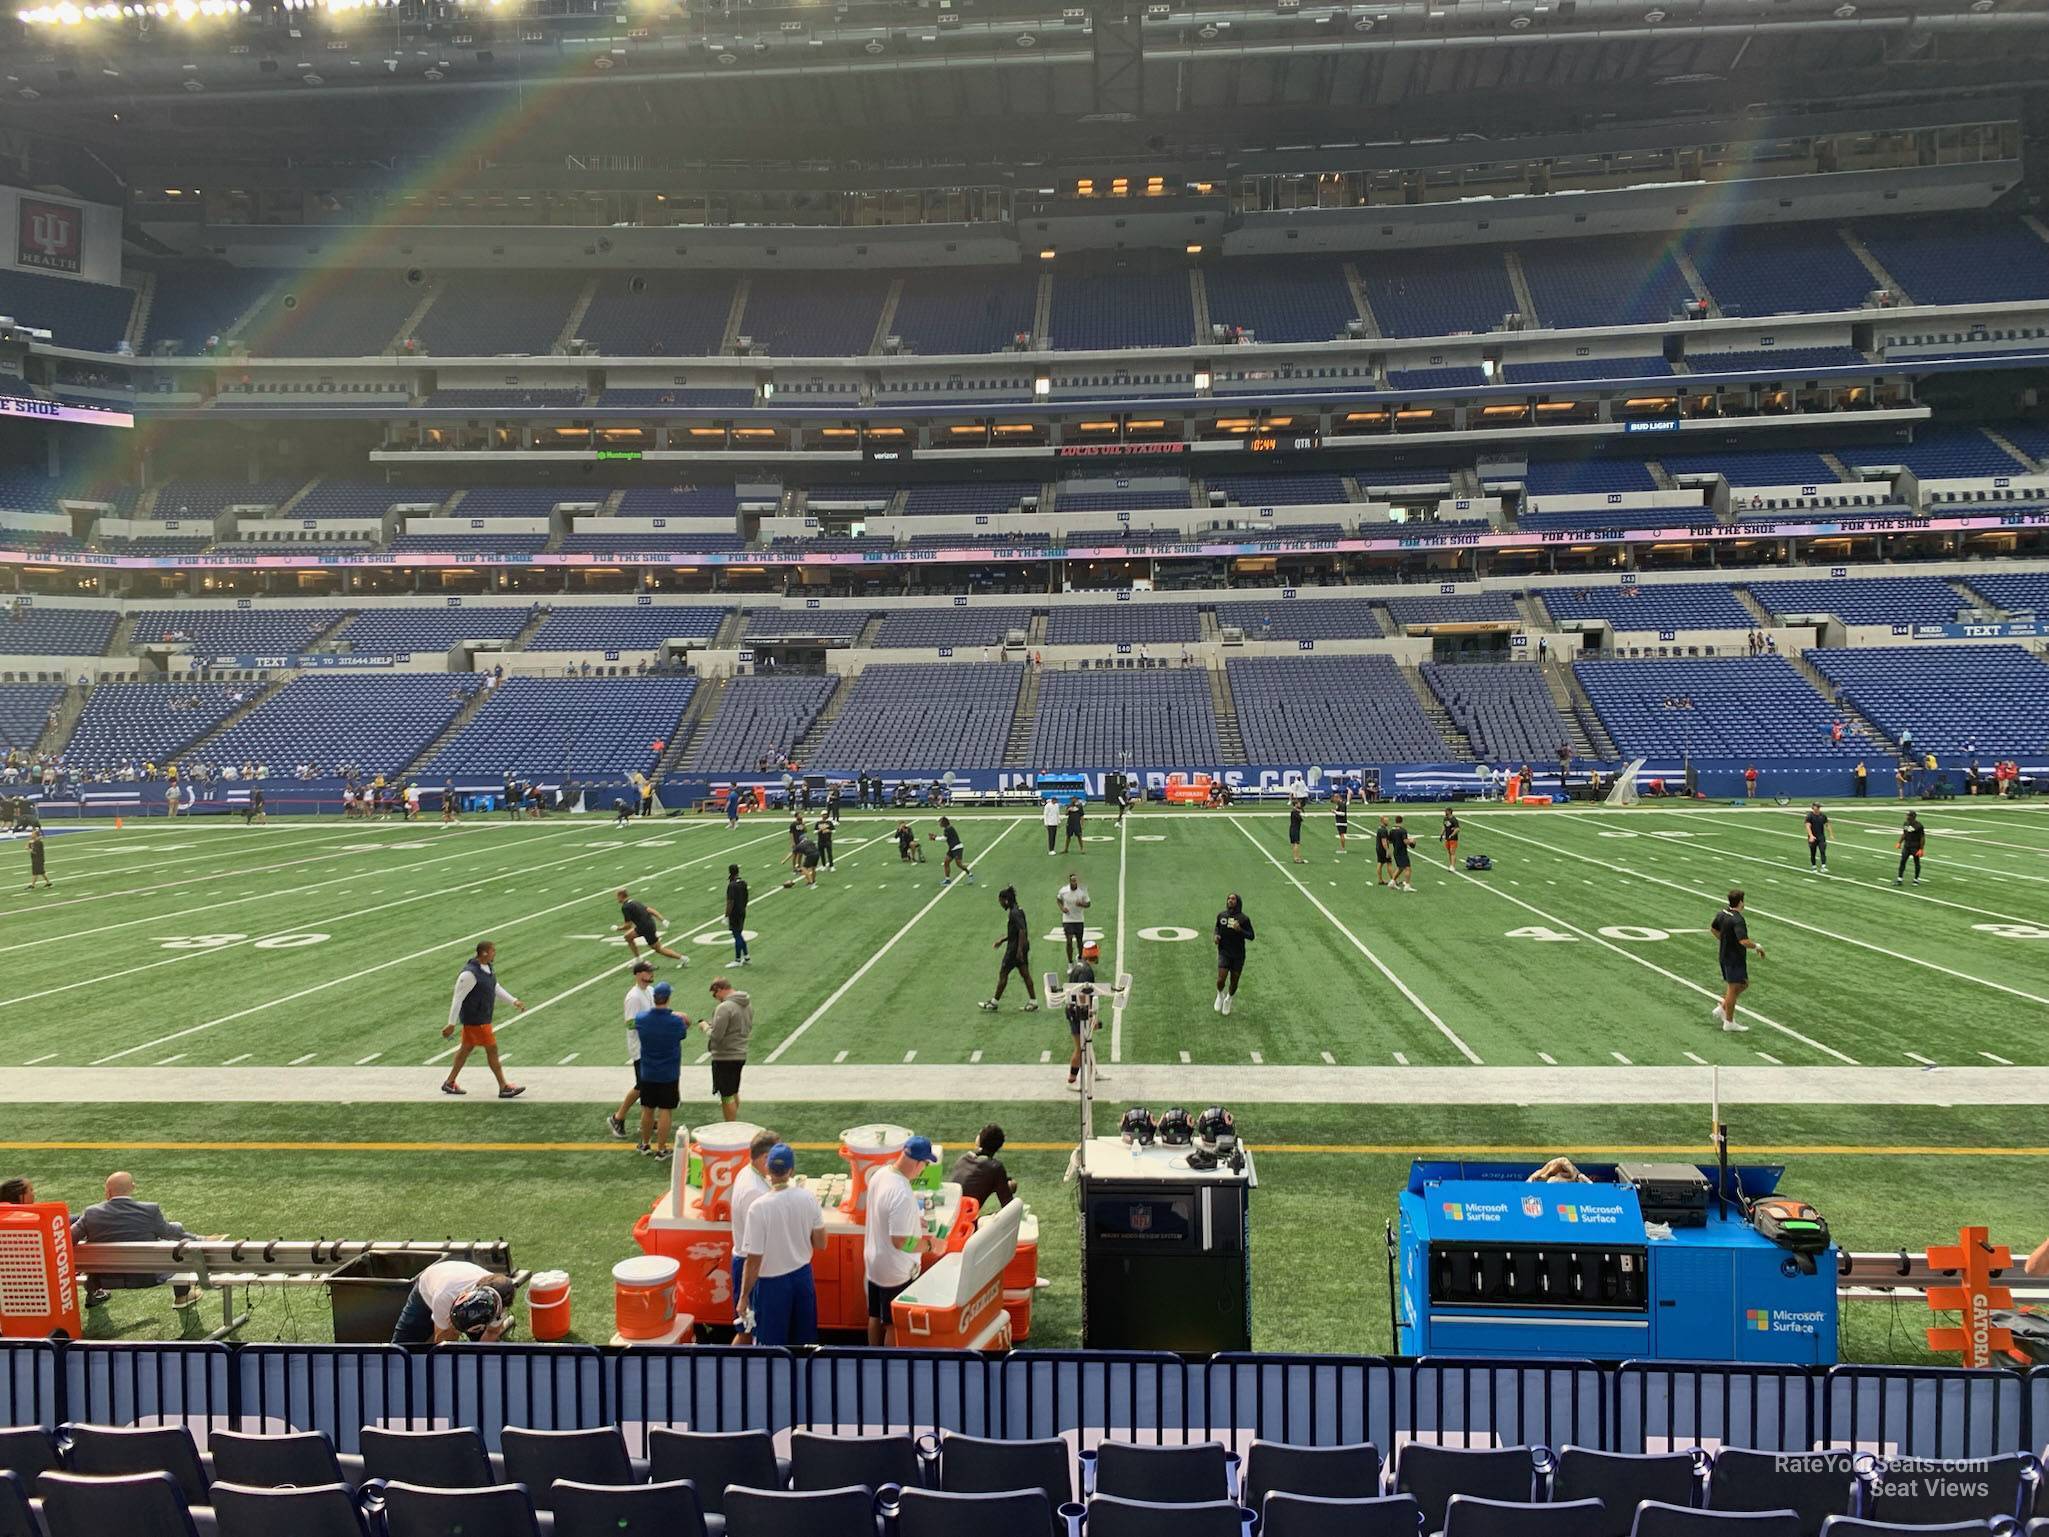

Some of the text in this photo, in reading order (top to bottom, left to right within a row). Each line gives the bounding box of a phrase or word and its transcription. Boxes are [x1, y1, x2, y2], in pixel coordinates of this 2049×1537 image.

[23, 253, 76, 270] HEALTH
[16, 402, 60, 416] SHOE
[1630, 422, 1674, 431] BUD LIGHT
[1294, 438, 1310, 448] QTR
[874, 452, 898, 460] verizon
[2000, 515, 2049, 525] FOR TH
[1690, 525, 1776, 536] FOR THE SHOE
[1841, 520, 1930, 532] FOR THE SHOE
[1542, 530, 1625, 542] FOR THE SHOE
[1260, 541, 1338, 551] FOR THE SHOE
[1398, 536, 1480, 548] FOR THE SHOE
[993, 549, 1068, 558] FOR THE SHOE
[1126, 545, 1202, 555] FOR THE SHOE
[594, 554, 672, 562] FOR THE SHOE
[752, 554, 774, 562] THE
[776, 554, 805, 562] SHOE
[863, 552, 938, 560] FOR THE SHOE
[1622, 575, 1634, 583] 243
[1660, 632, 1674, 640] 143
[1893, 627, 1907, 636] 144
[1964, 626, 2001, 636] TEXT
[1300, 641, 1312, 649] 141
[1512, 637, 1526, 645] 142
[940, 648, 952, 656] 139
[1118, 644, 1130, 652] 140
[396, 654, 409, 662] 136
[606, 652, 618, 660] 137
[255, 656, 288, 668] TEXT
[1504, 926, 1670, 941] 40
[160, 932, 332, 949] 30
[710, 1161, 732, 1187] G
[1466, 1203, 1508, 1214] Microsoft
[1580, 1204, 1624, 1214] Microsoft
[1466, 1212, 1500, 1222] Surface
[1582, 1214, 1616, 1224] Surface
[52, 1215, 74, 1315] GATORADE
[1773, 1310, 1824, 1322] Microsoft
[1773, 1322, 1814, 1334] Surface
